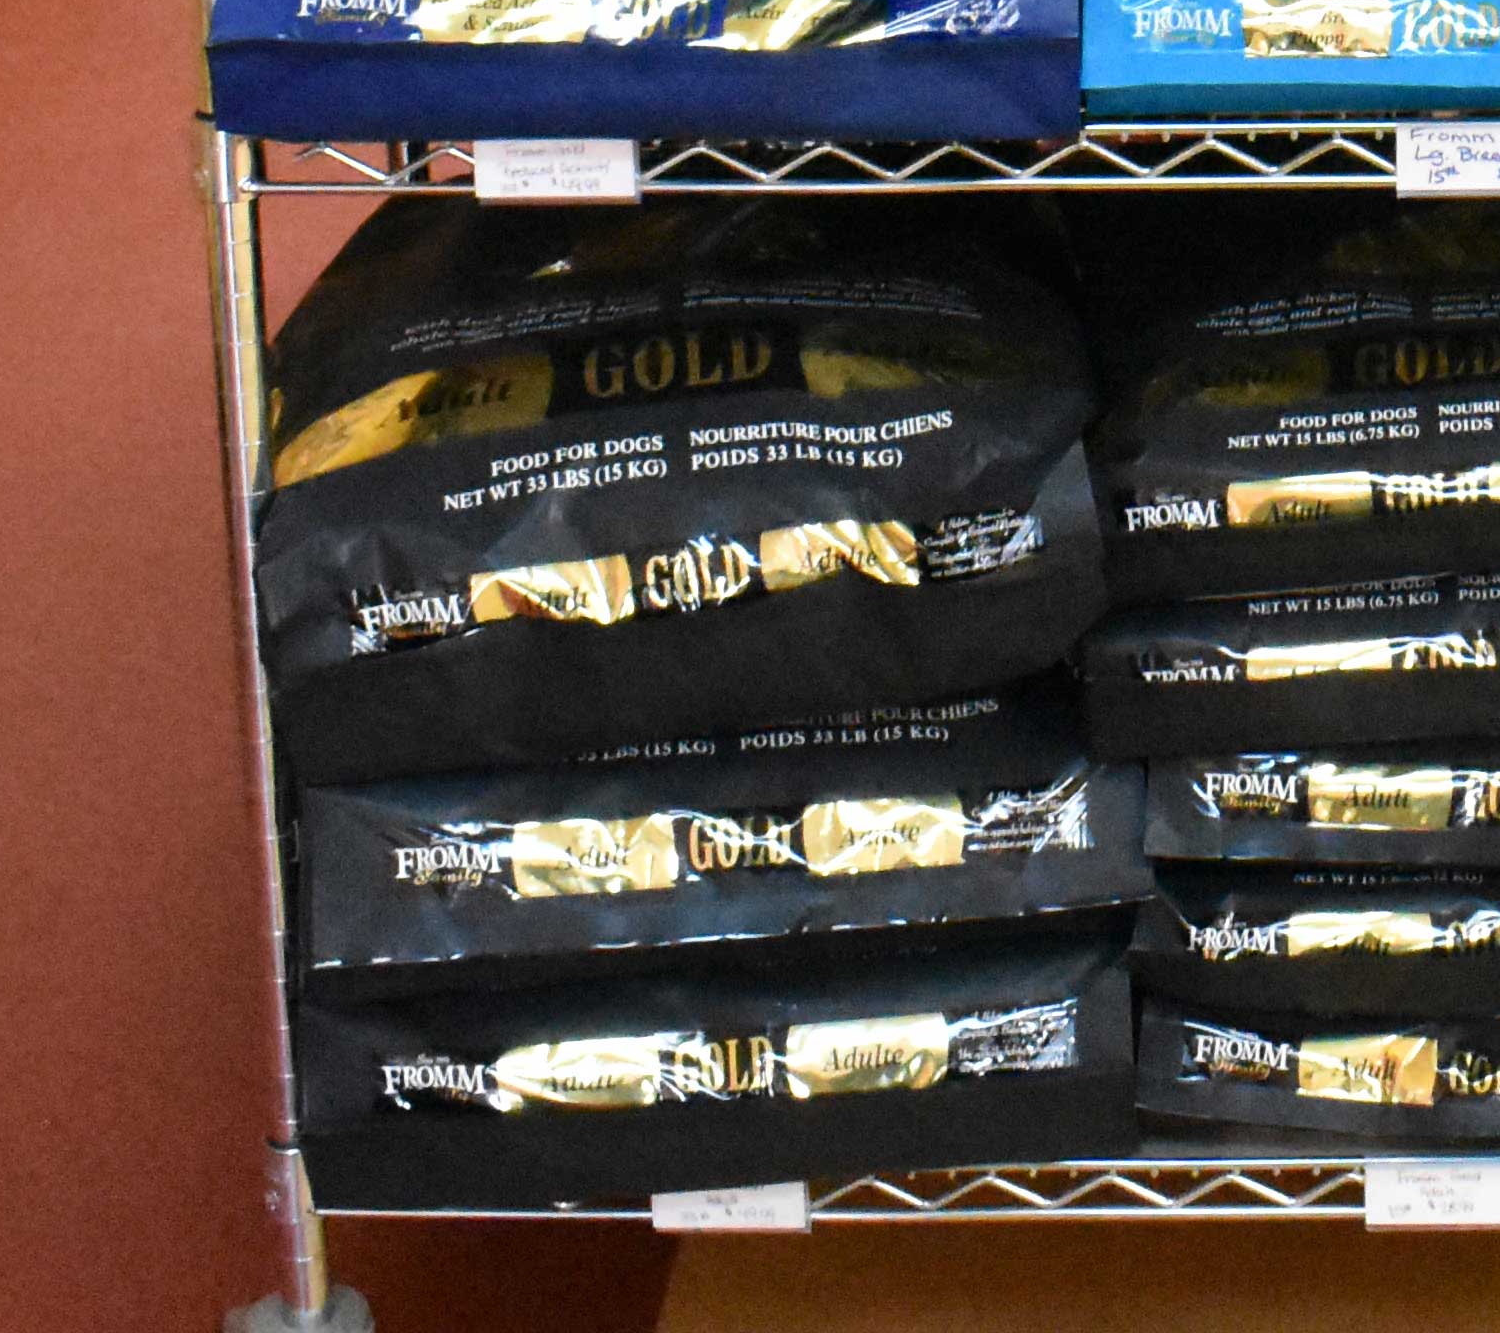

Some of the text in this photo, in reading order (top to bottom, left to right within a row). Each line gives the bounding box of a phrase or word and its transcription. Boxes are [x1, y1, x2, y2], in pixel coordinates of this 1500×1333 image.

[1410, 125, 1495, 143] Fromm
[1414, 144, 1449, 166] Lg.
[583, 332, 772, 400] GOLD
[689, 409, 954, 448] NOURRITURE POUR CHIENS
[1279, 406, 1418, 431] FOOD FOR DOGS
[490, 435, 664, 478] FOOD FOR DOGS
[690, 443, 904, 471] POIDS 33 LB (15 KG)
[442, 458, 668, 511] NET WT 33 LBS (15 KG)
